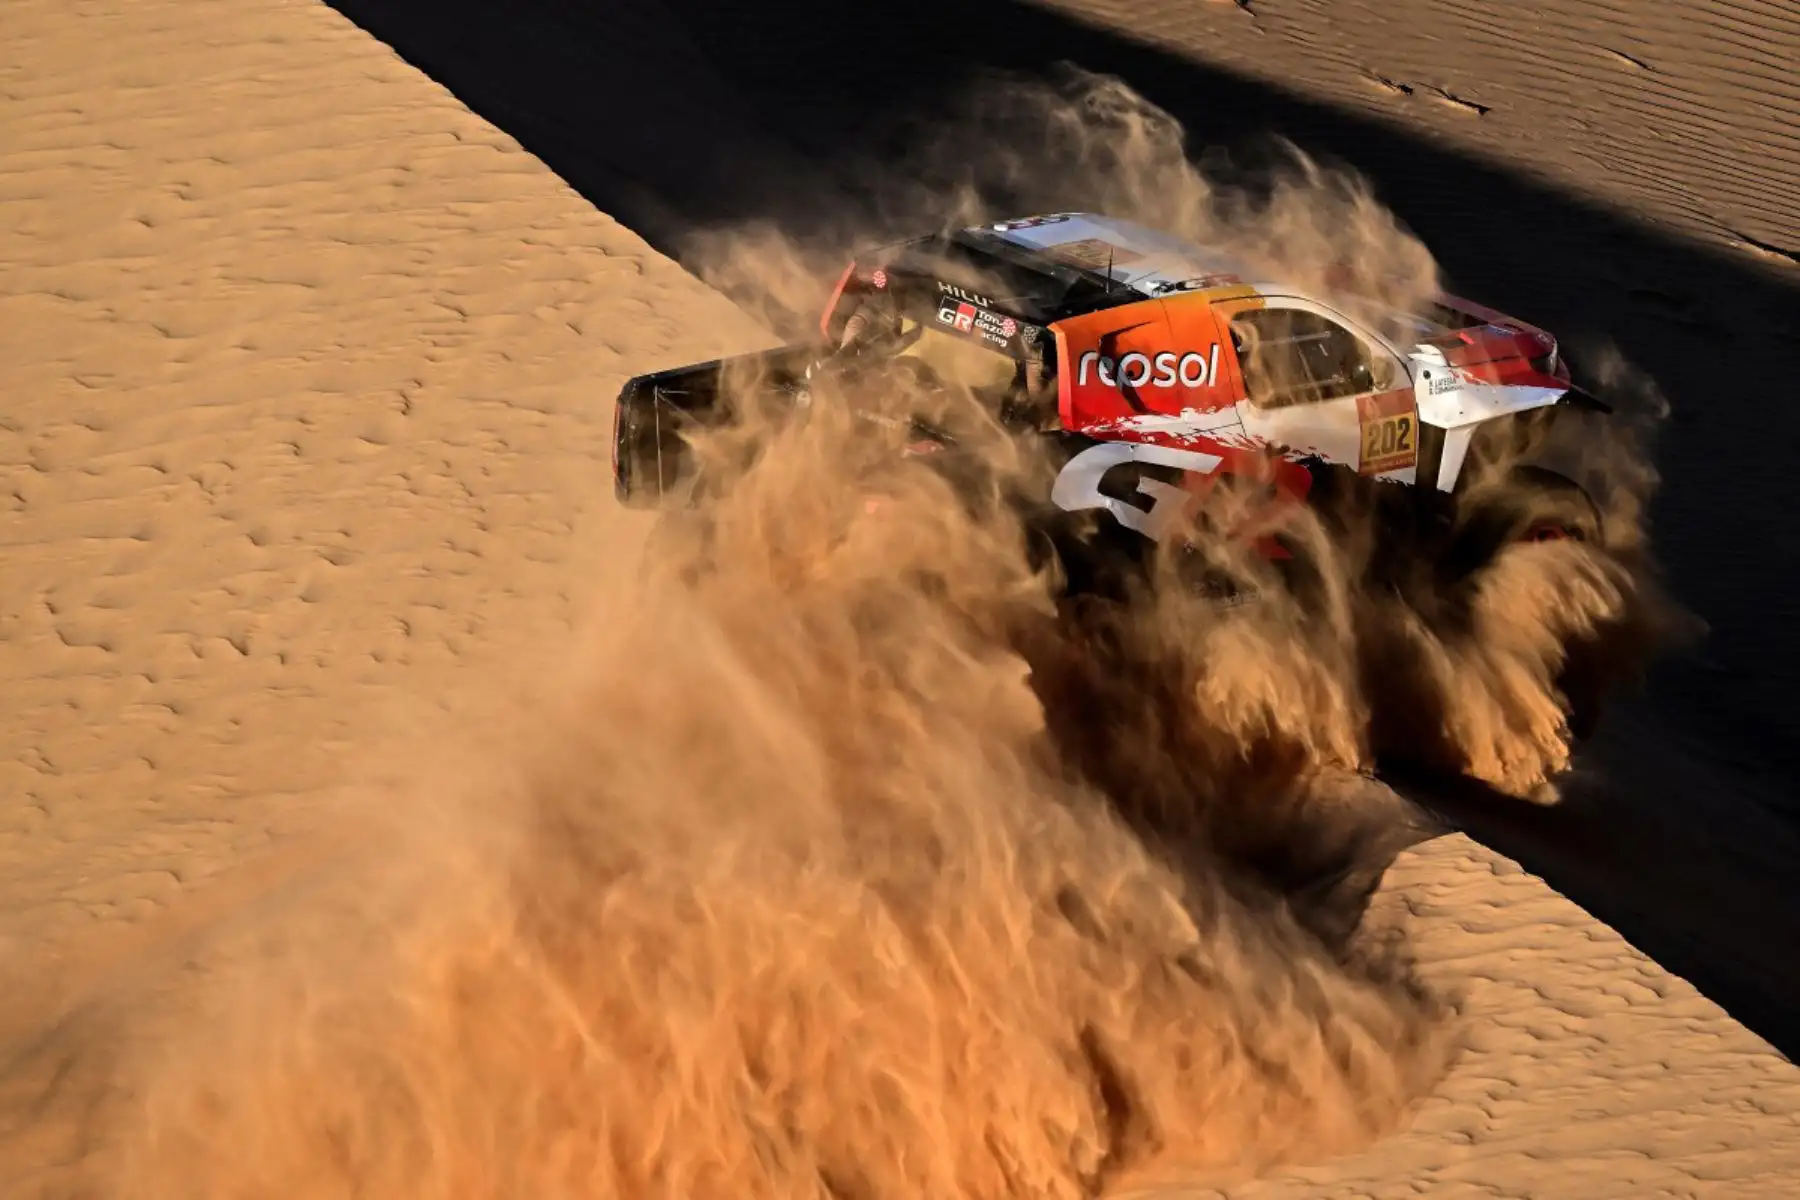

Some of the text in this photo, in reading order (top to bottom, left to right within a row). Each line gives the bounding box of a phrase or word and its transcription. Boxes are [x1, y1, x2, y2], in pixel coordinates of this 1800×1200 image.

[938, 281, 994, 308] HILU
[938, 308, 972, 332] GR
[1367, 417, 1410, 457] 202
